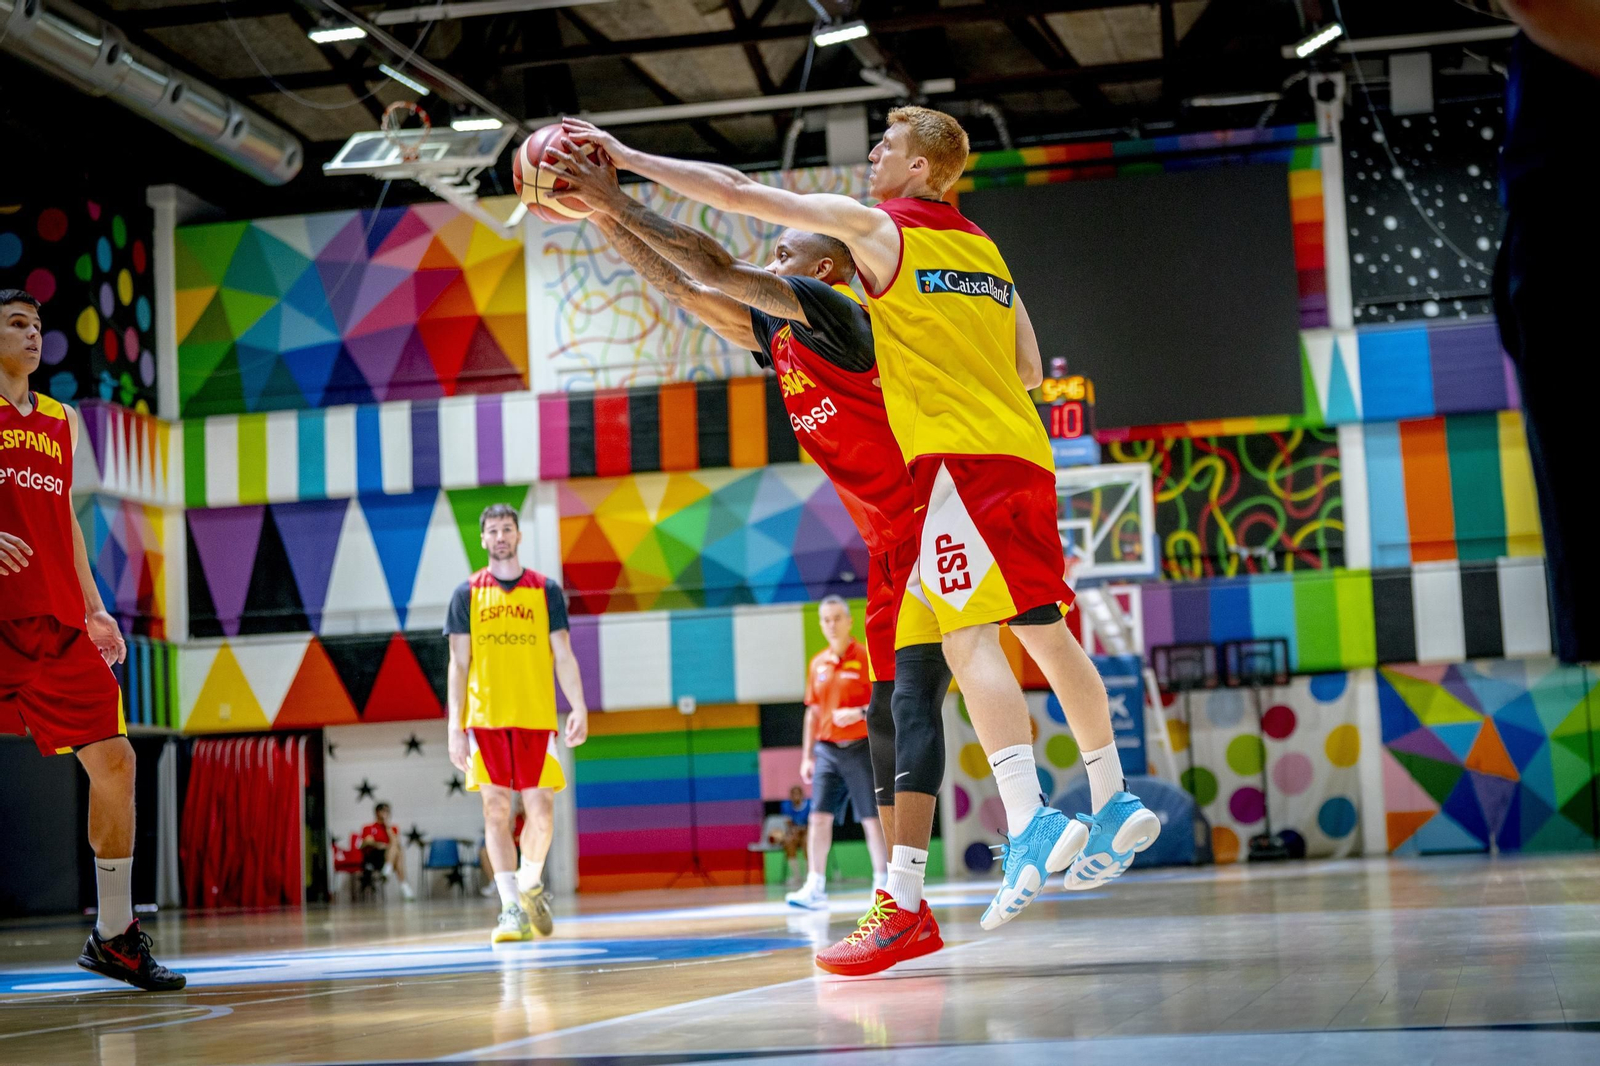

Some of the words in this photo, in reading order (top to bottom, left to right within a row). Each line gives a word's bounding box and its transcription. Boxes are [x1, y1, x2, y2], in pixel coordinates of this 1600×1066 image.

[944, 271, 1010, 305] CaixaBank
[1050, 401, 1084, 439] 10
[935, 533, 972, 595] ESP
[480, 604, 535, 623] ESPAÑA
[477, 631, 537, 646] endesa
